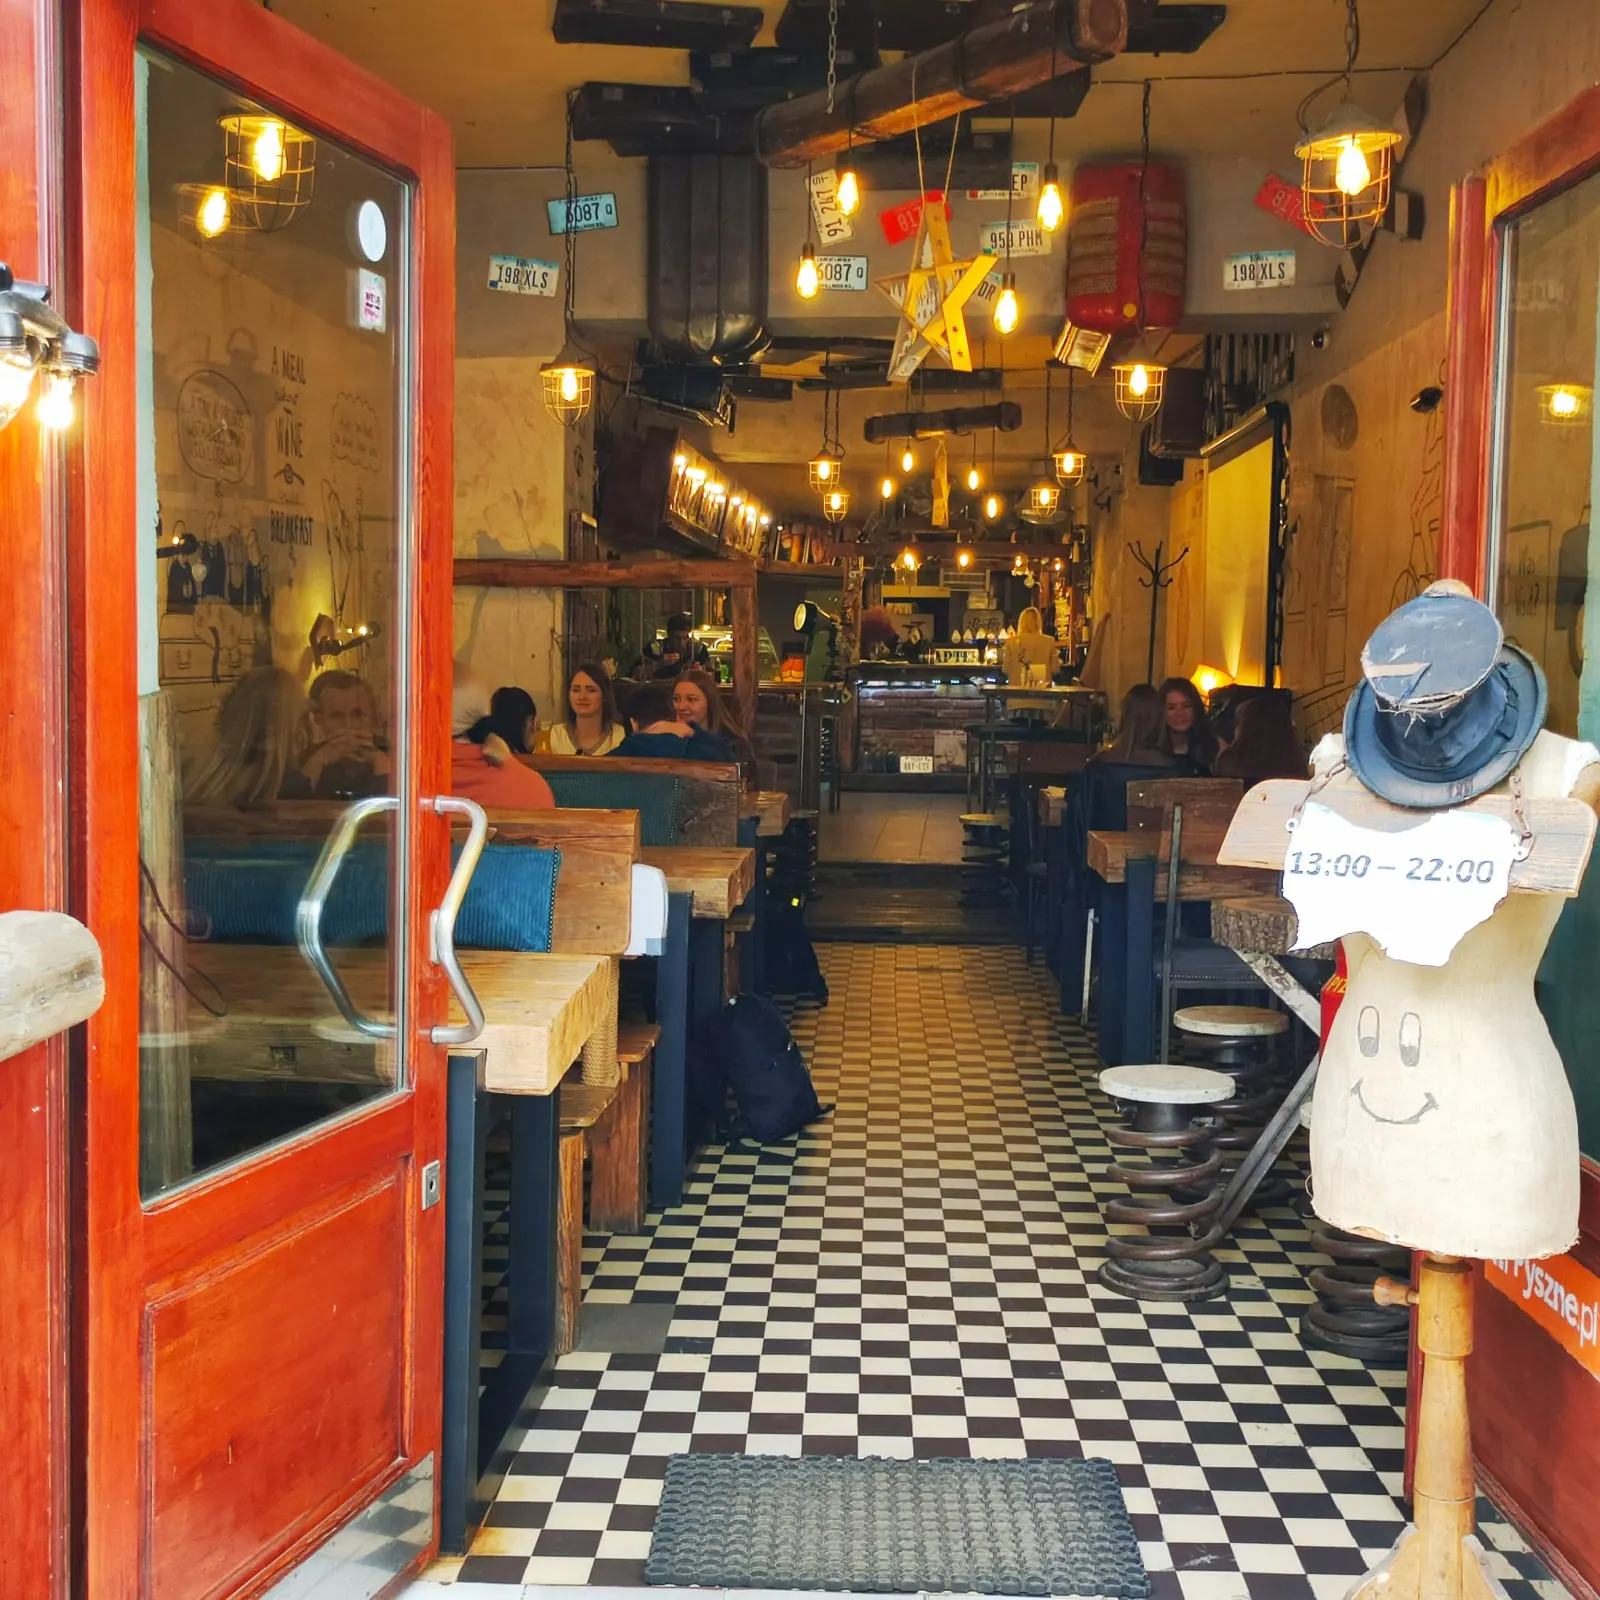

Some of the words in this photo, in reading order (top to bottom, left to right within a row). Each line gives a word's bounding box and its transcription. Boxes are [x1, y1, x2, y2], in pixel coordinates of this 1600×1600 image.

[497, 264, 520, 285] 198
[522, 267, 549, 290] XLS
[1232, 263, 1256, 282] 198
[1260, 261, 1286, 280] XLS
[269, 509, 314, 547] BREAKFAST
[1289, 851, 1372, 878] 13:00
[1405, 857, 1495, 884] 22:00
